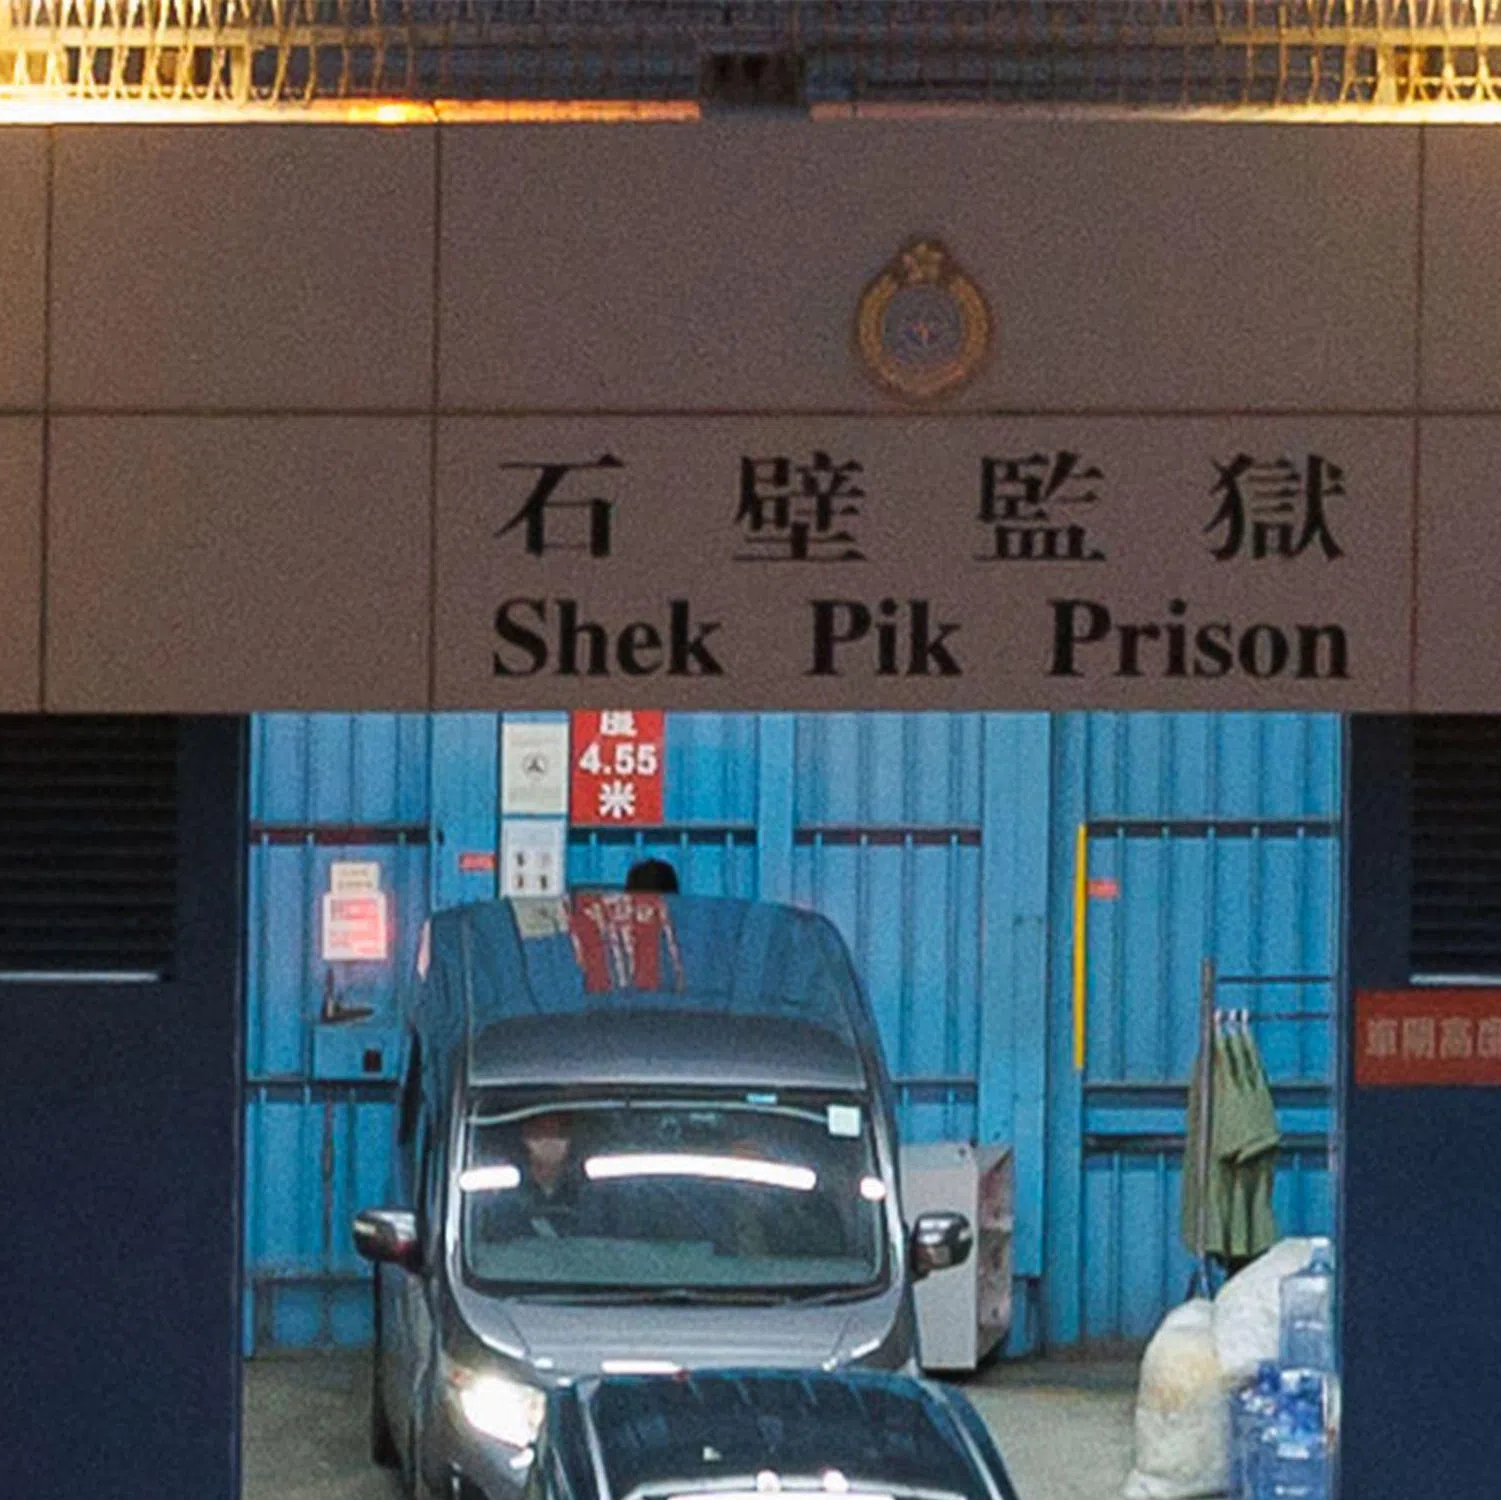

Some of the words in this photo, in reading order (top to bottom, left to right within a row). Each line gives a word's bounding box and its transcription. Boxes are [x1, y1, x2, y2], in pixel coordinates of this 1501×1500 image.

[493, 450, 1347, 563] 石壁監獄
[493, 597, 725, 678] Shek
[804, 598, 963, 678] Pik
[1048, 597, 1351, 680] Prison
[578, 742, 658, 776] 4.55
[598, 779, 637, 819] 米
